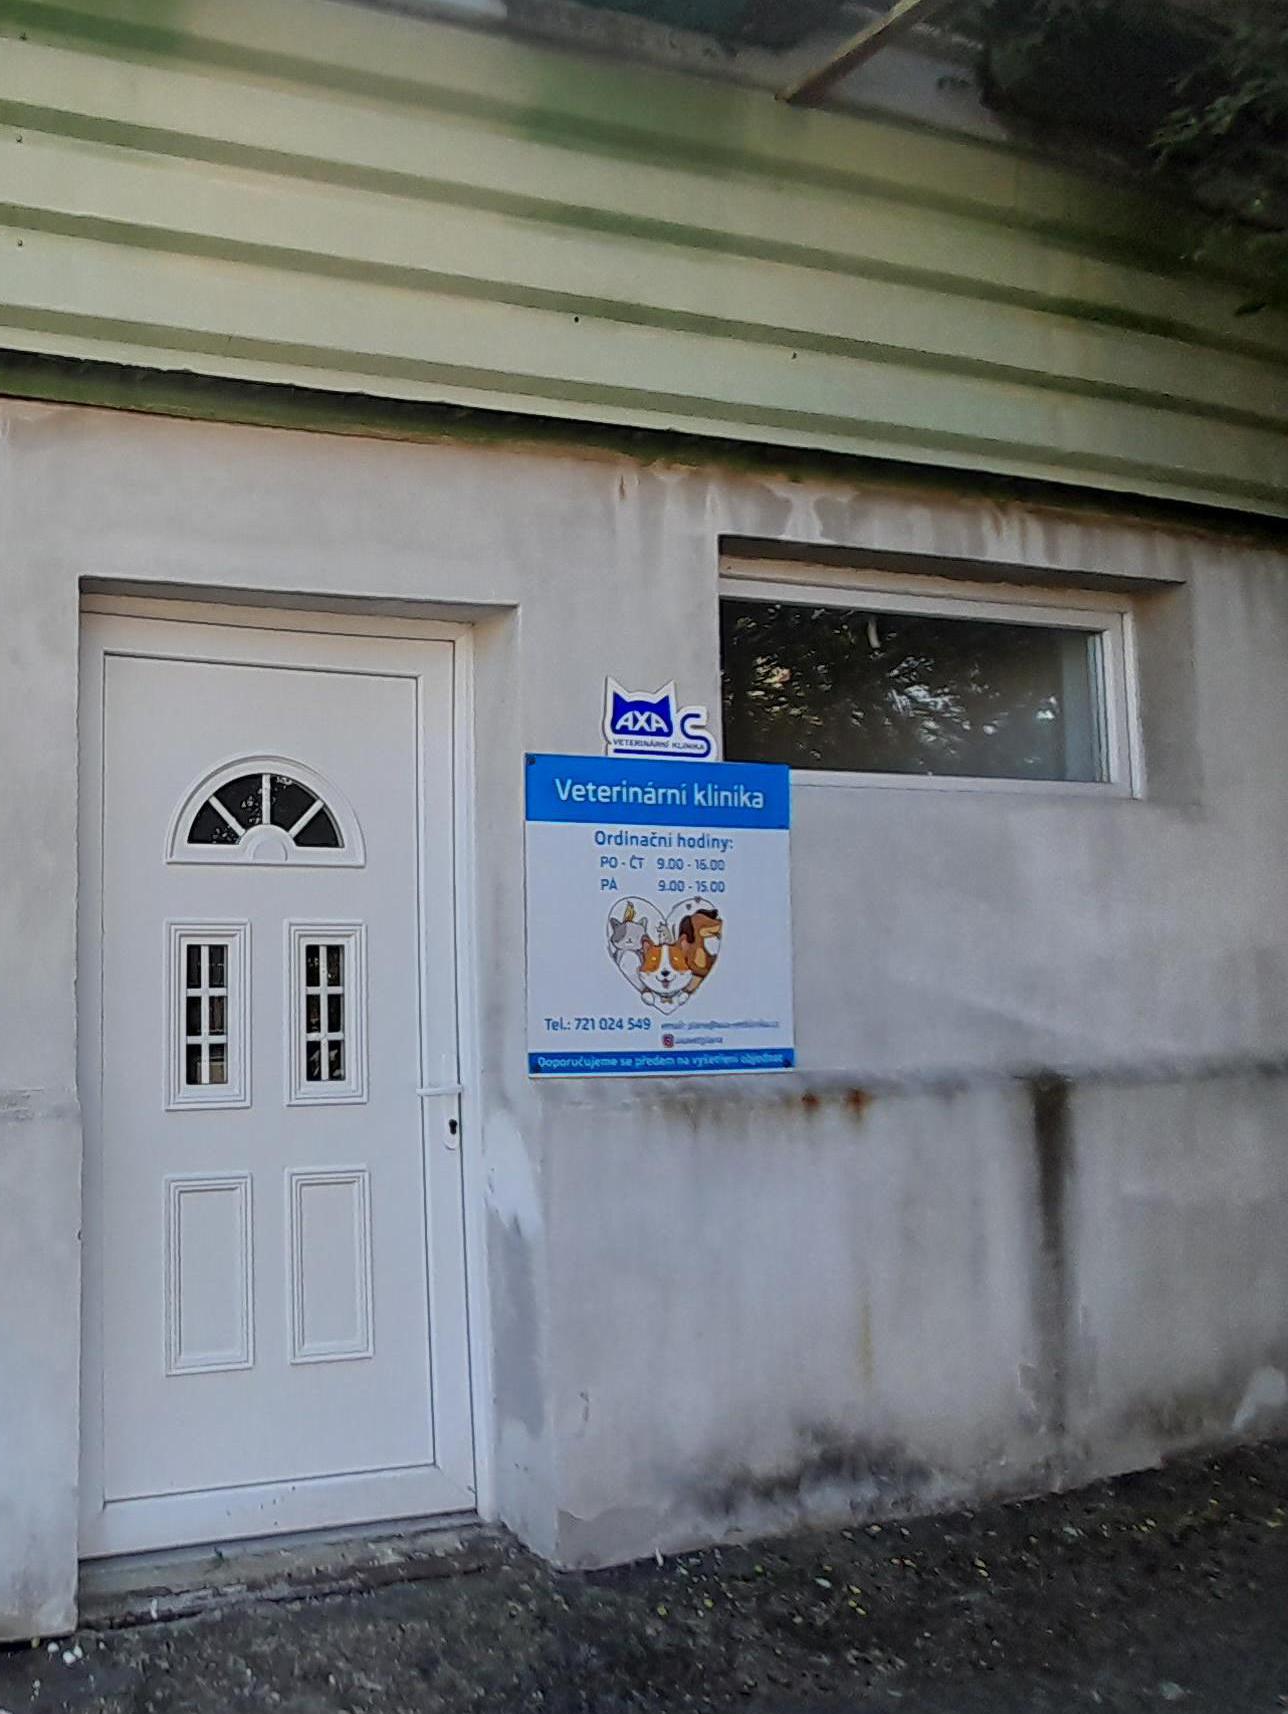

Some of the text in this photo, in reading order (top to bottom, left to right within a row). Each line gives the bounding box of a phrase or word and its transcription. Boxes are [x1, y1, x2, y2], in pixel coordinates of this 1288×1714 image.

[615, 709, 669, 733] AXA
[555, 778, 687, 806] Veterinární
[676, 832, 735, 853] hodiny:
[599, 855, 619, 869] PO
[629, 854, 644, 869] ČT
[656, 857, 684, 870] 9.00
[657, 879, 685, 892] 9.00
[574, 1017, 596, 1031] 721
[598, 1017, 624, 1031] 024
[627, 1017, 652, 1031] 549
